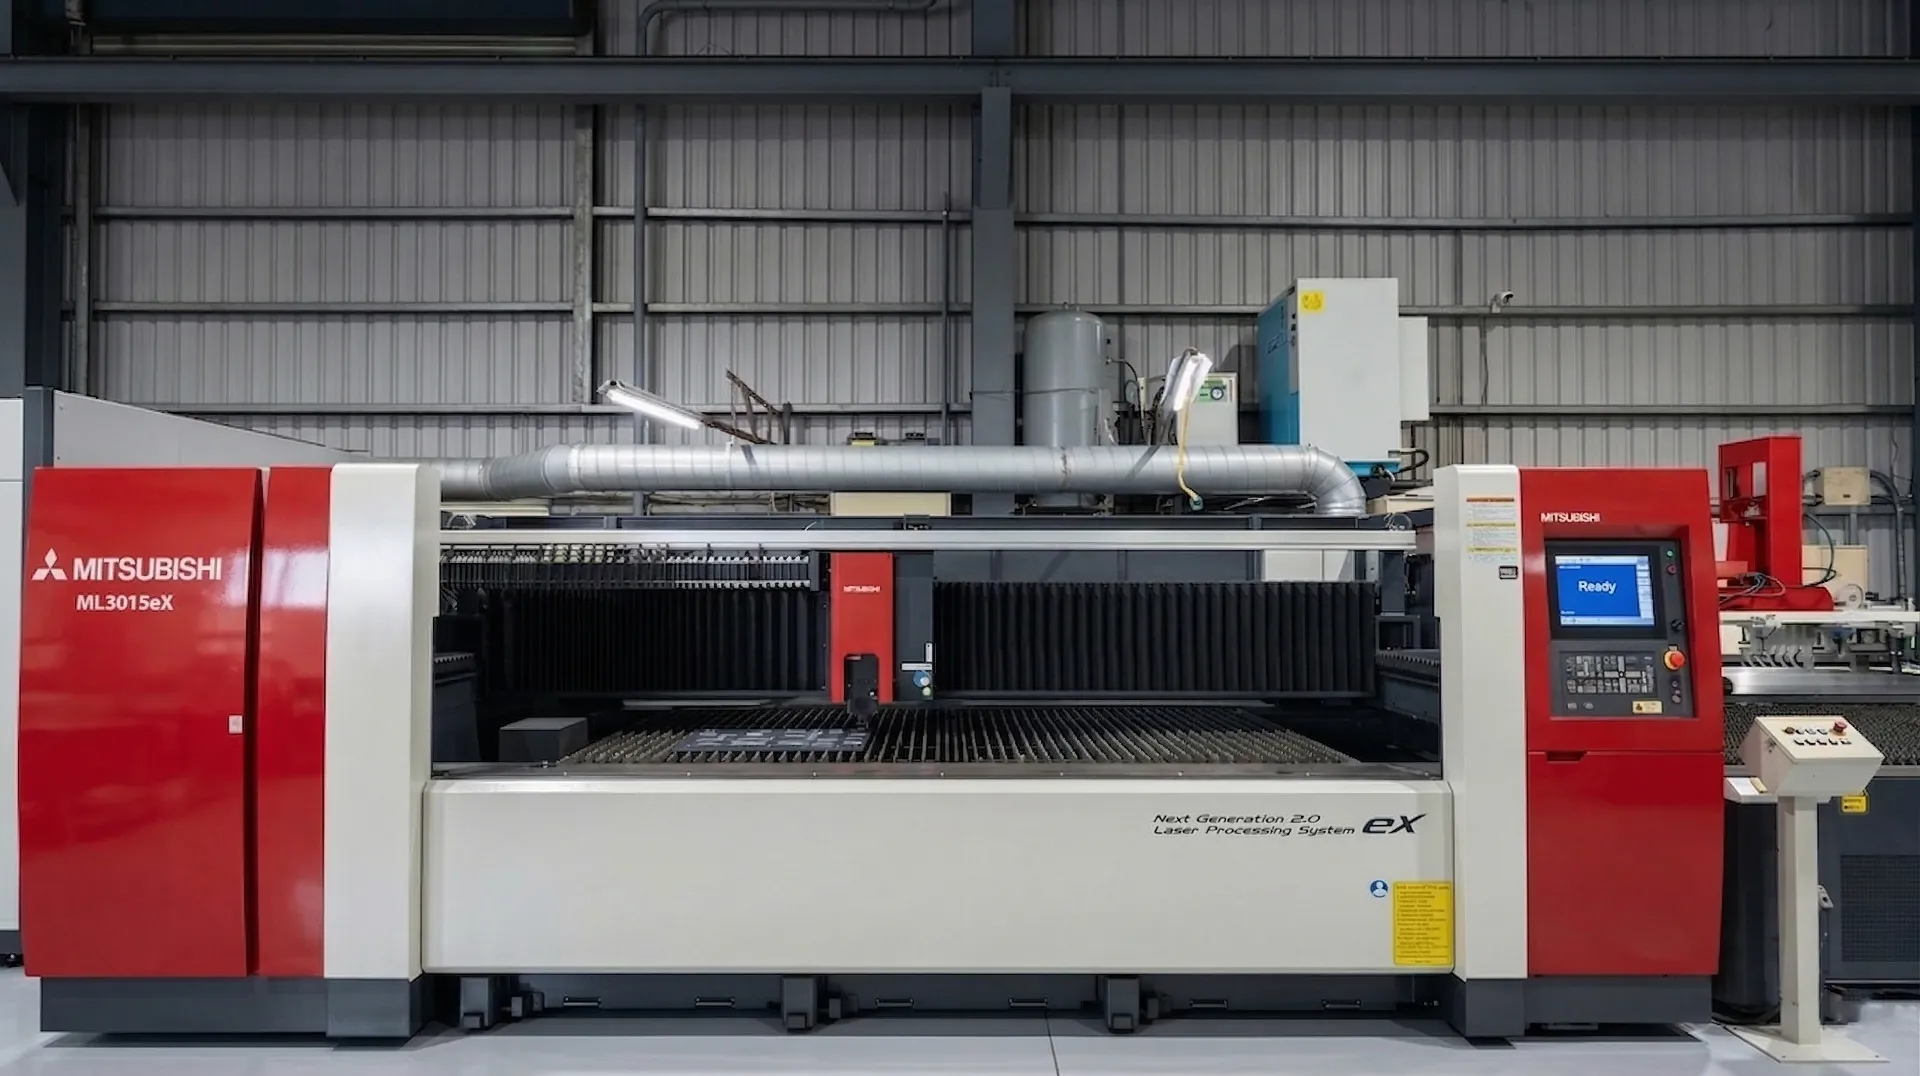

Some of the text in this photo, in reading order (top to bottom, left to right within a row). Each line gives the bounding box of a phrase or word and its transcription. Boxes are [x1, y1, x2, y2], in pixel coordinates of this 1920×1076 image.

[1541, 512, 1600, 522] MITSUBISHI
[73, 557, 222, 580] MITSUBISHI
[1578, 580, 1616, 594] Ready
[76, 594, 174, 610] ML3015eX
[1153, 813, 1321, 823] Next Generation 2.0
[1153, 825, 1355, 837] Laser Processing System
